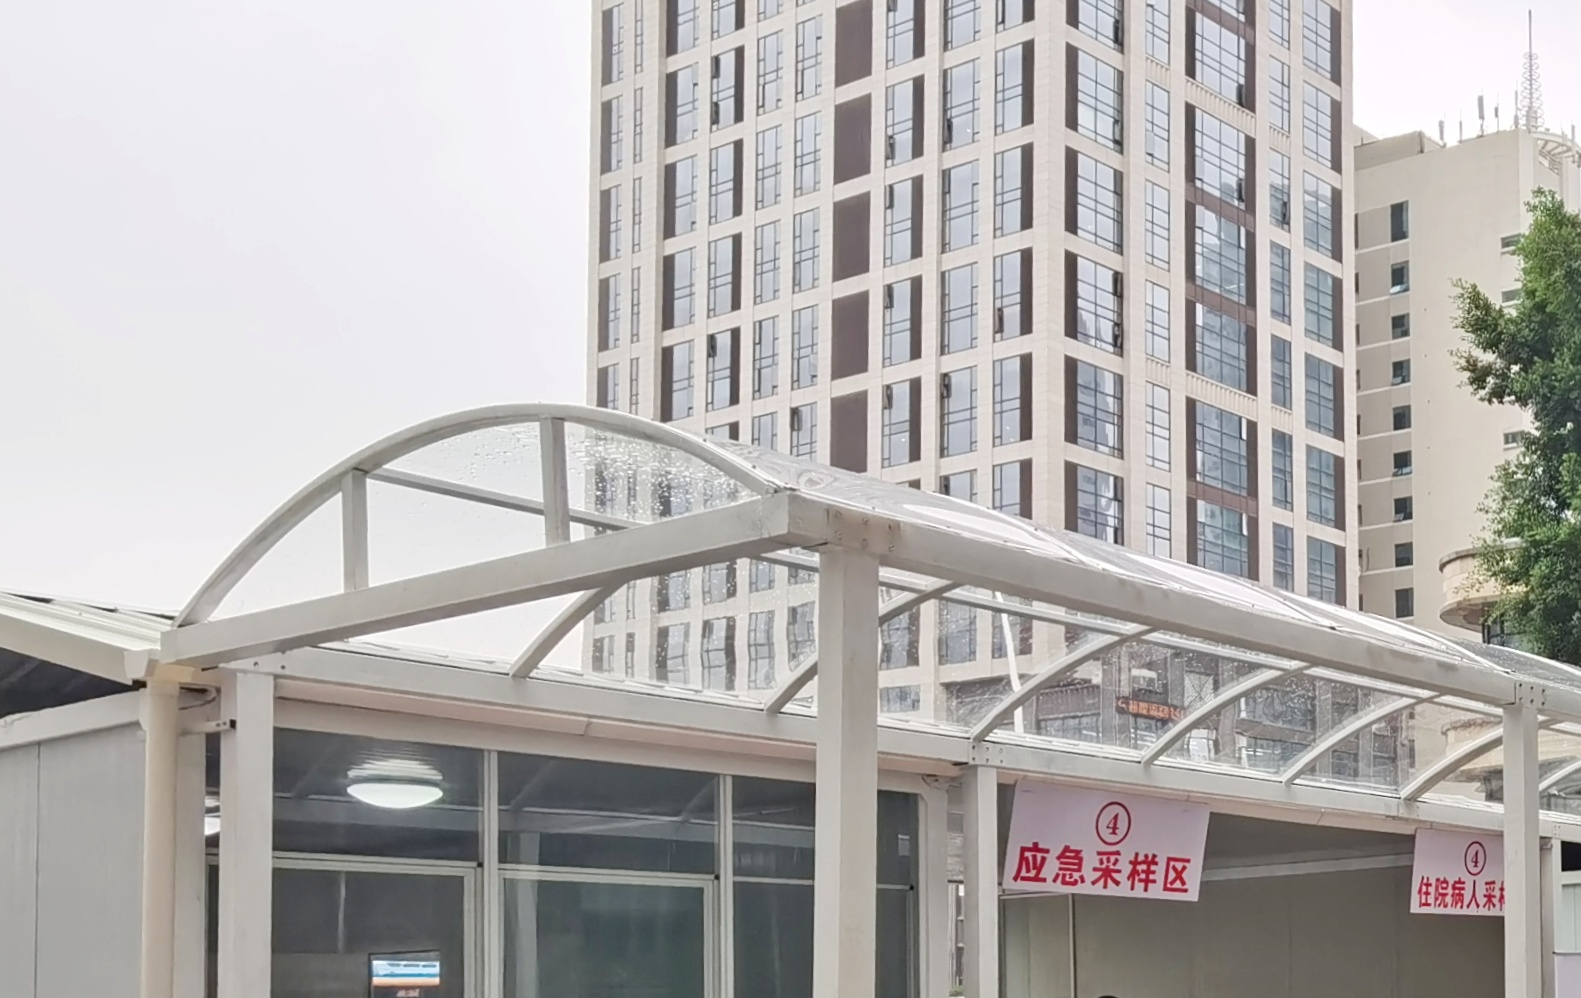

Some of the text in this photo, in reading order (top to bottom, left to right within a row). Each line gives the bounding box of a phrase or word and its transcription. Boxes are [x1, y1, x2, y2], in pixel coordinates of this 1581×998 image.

[1012, 842, 1191, 893] 应急采样区
